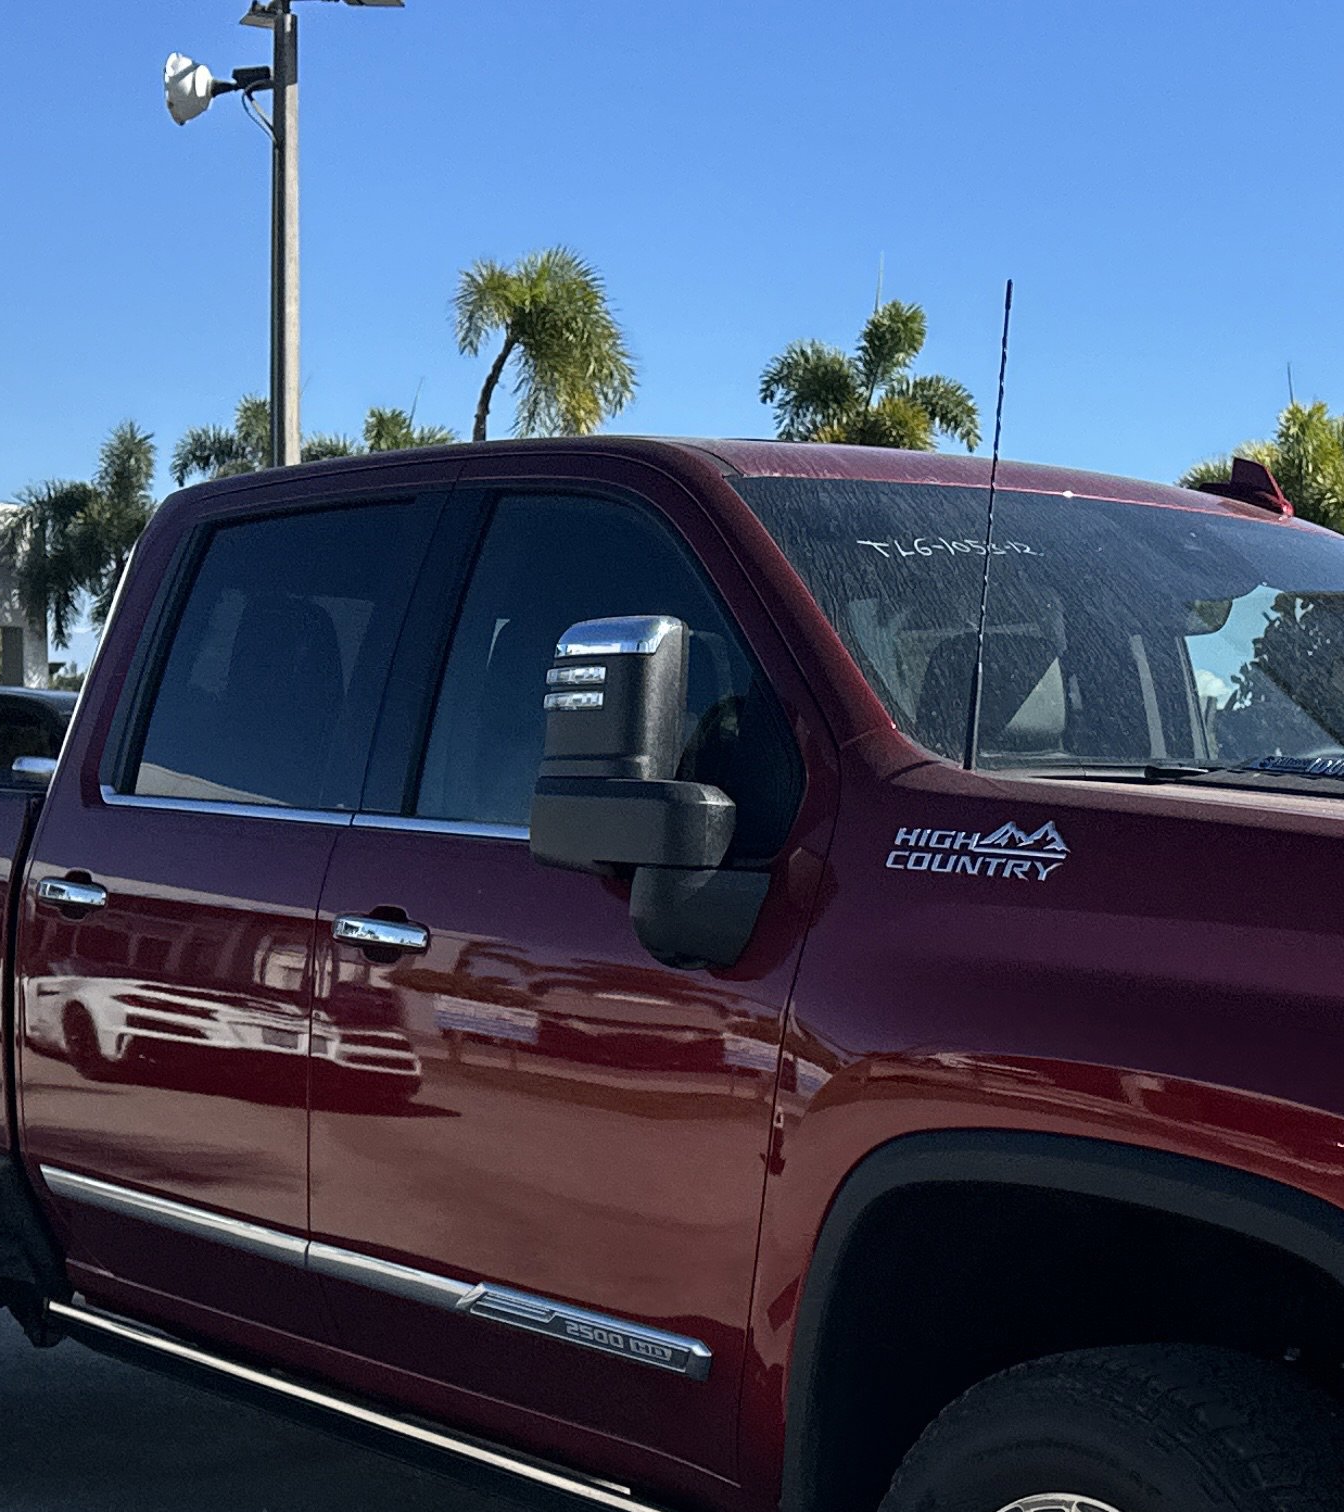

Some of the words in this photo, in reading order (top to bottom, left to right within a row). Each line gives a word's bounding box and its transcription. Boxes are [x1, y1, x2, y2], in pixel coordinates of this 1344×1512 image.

[894, 827, 981, 851] HIGH
[885, 850, 1064, 882] COUNTRY
[564, 1320, 624, 1349] 2500
